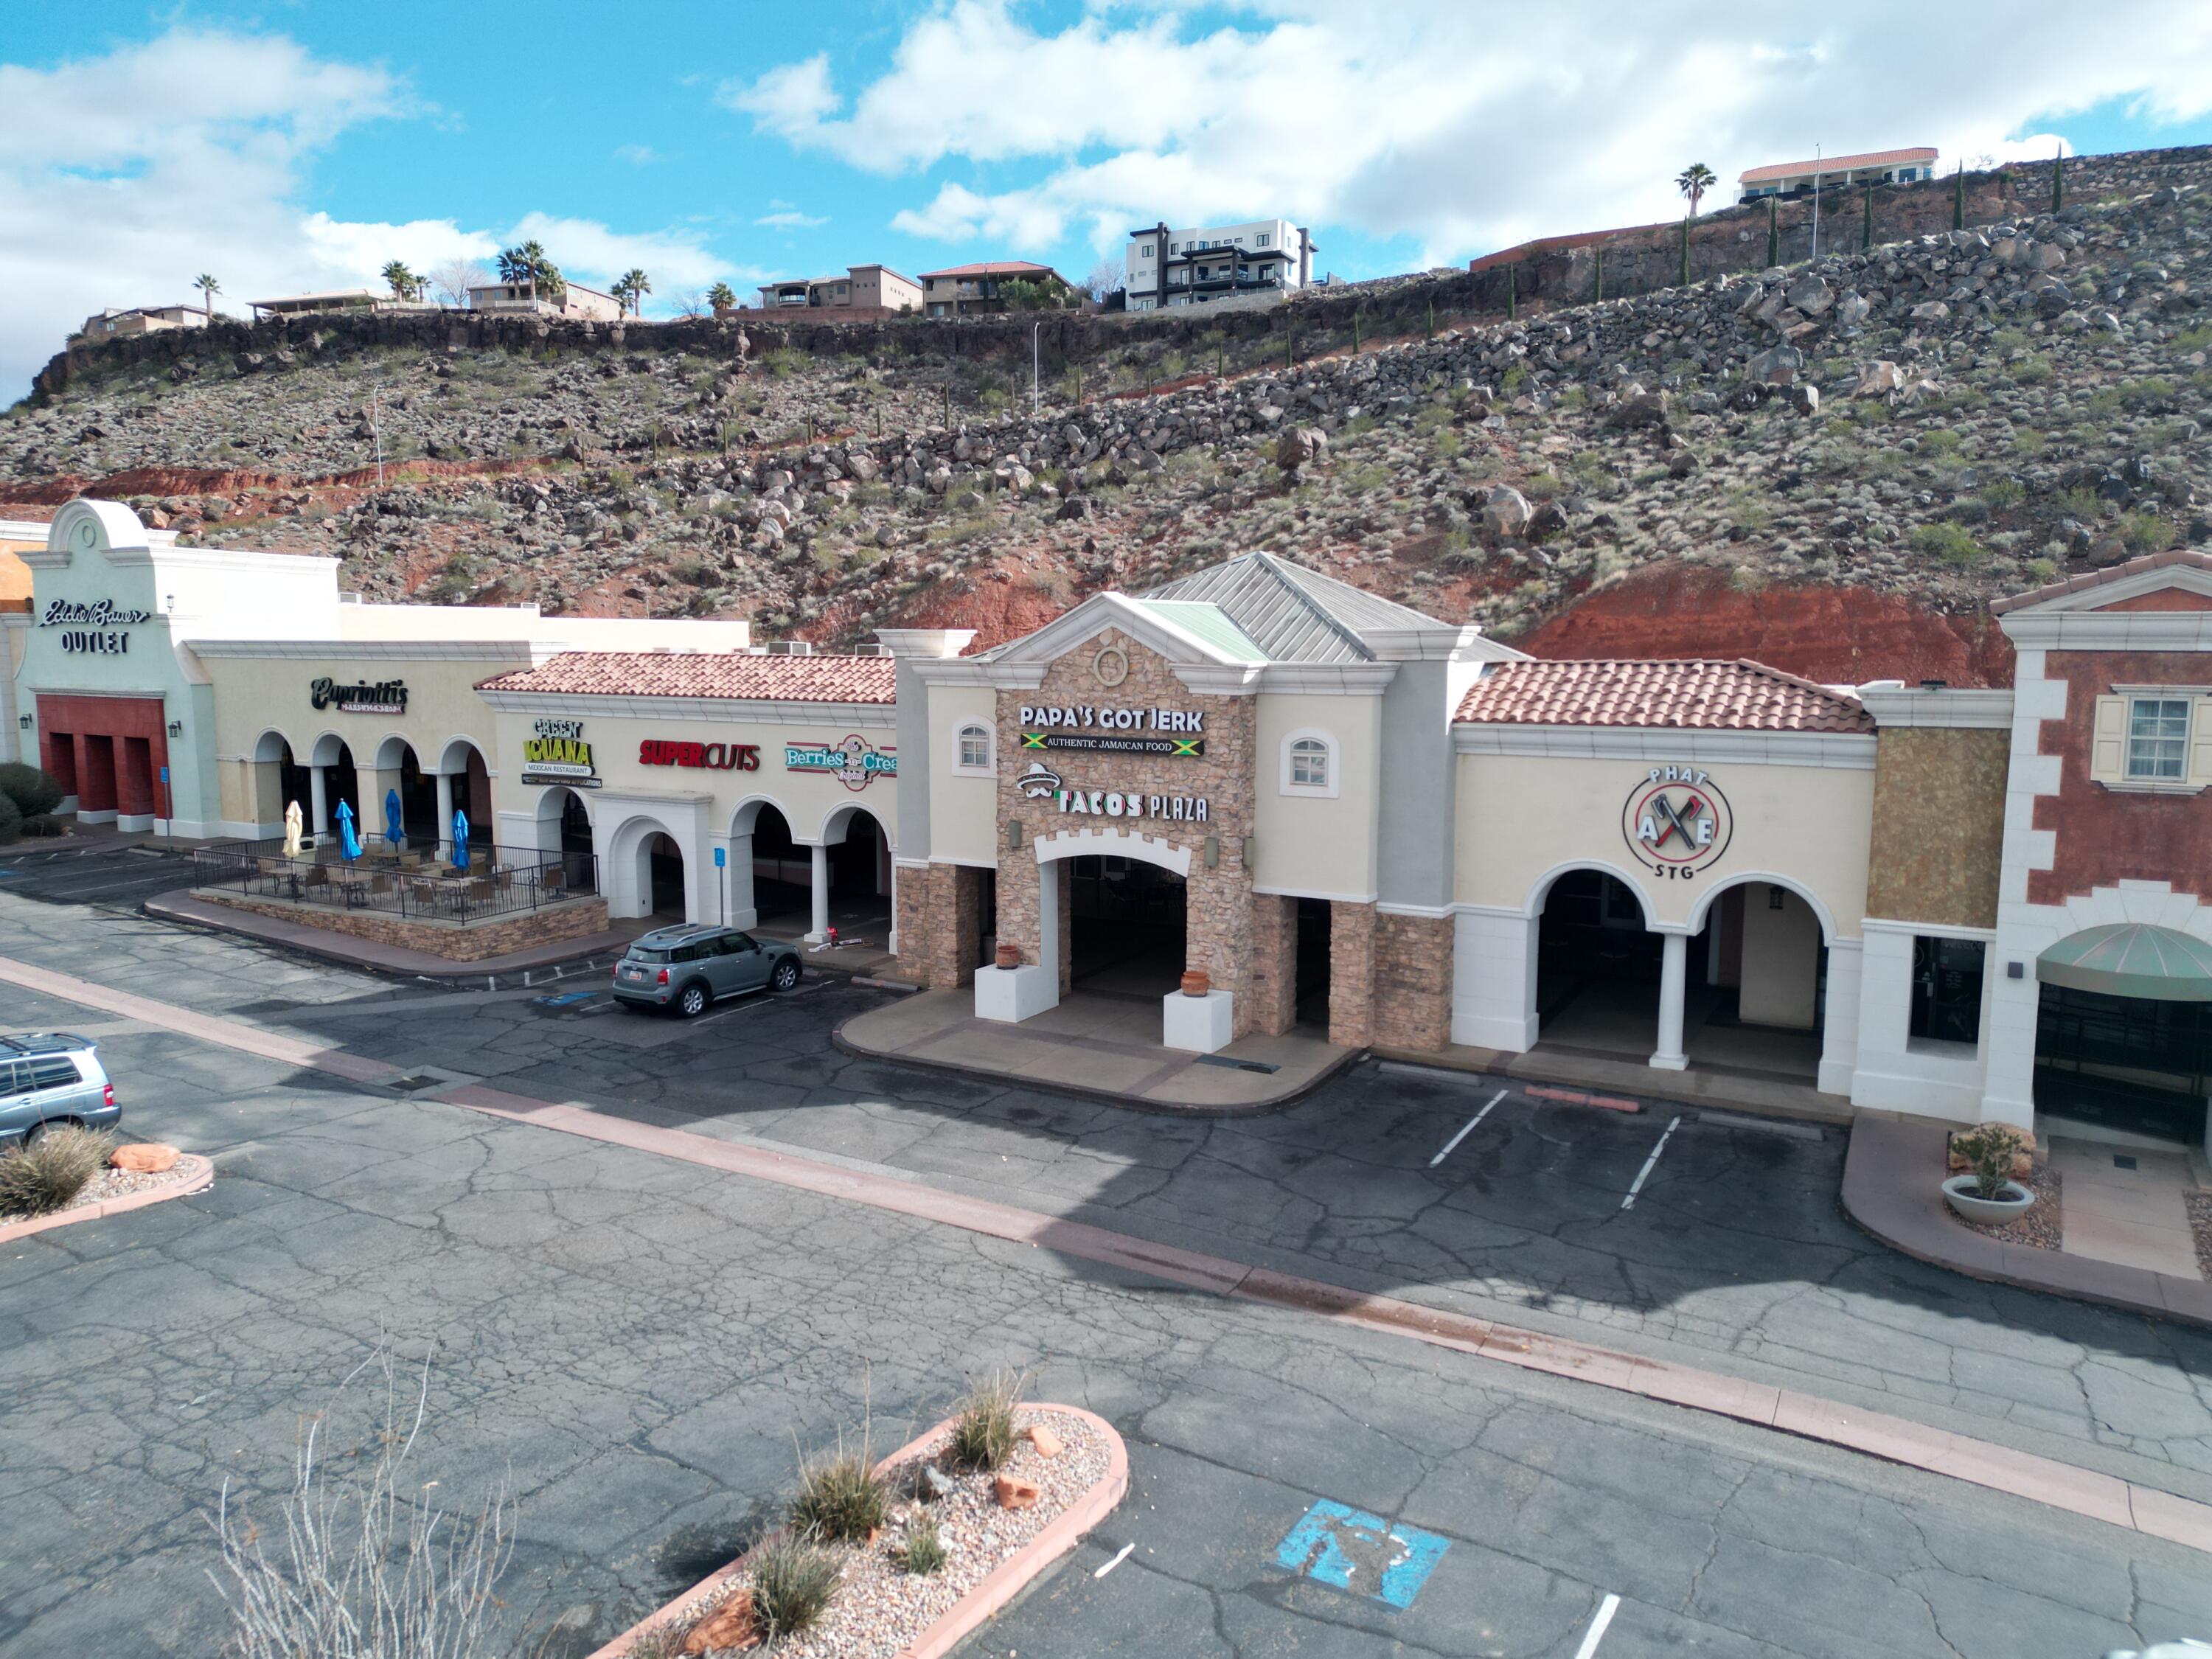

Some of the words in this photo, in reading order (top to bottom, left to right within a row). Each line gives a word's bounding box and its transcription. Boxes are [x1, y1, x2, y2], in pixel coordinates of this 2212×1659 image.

[40, 599, 89, 626] Eddie
[89, 599, 150, 626] Bauer
[60, 631, 128, 653] OUTLET
[310, 677, 408, 710] Capriotti's
[533, 719, 583, 739] GREEN
[1020, 706, 1095, 728] PAPA'S
[1099, 709, 1144, 729] GOT
[1150, 708, 1204, 732] JERK
[523, 738, 593, 765] IGUANA
[1047, 738, 1097, 748] AUTHENTIC
[1099, 740, 1144, 751] JAMAICAN
[1145, 742, 1172, 751] FOOD
[639, 740, 760, 771] SUPERCUTS
[785, 749, 845, 766] Berries
[528, 764, 552, 773] MEXICAN
[553, 765, 588, 774] RESTAURANT
[839, 769, 866, 781] Original
[1649, 766, 1708, 786] PHAT
[1054, 790, 1144, 817] TACOS
[1150, 796, 1208, 822] PLAZA
[1655, 864, 1694, 880] STG
